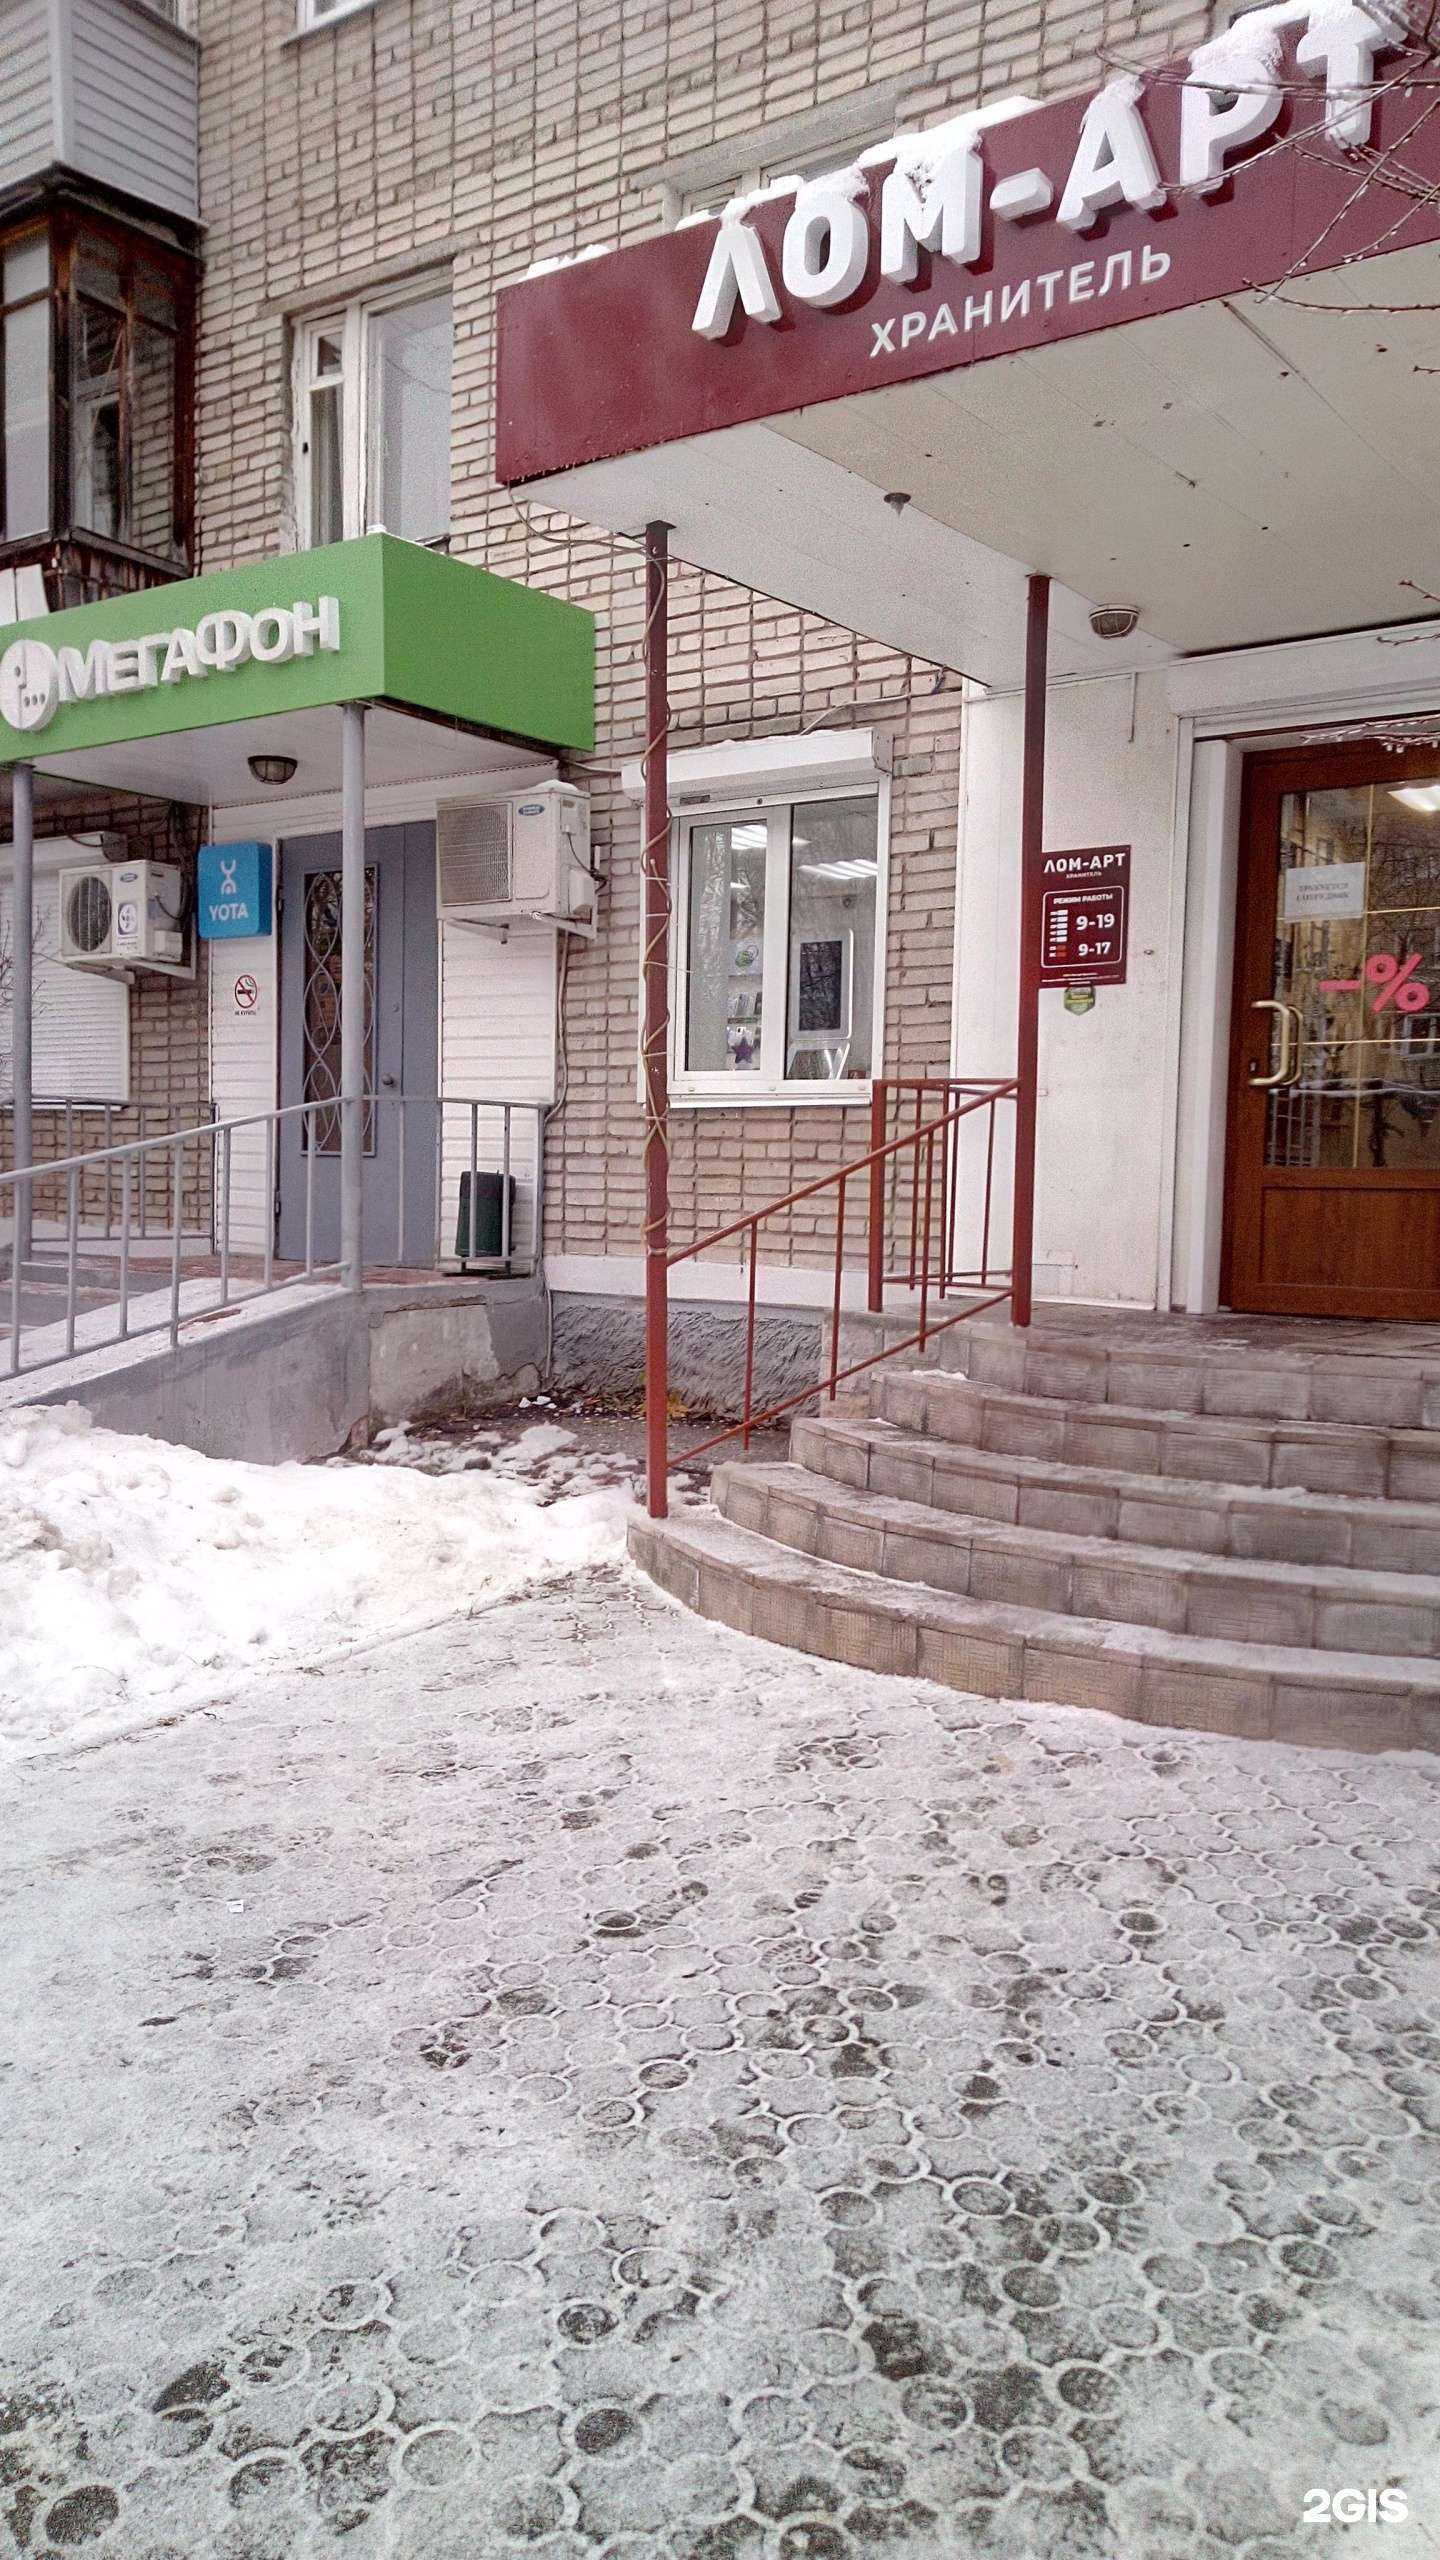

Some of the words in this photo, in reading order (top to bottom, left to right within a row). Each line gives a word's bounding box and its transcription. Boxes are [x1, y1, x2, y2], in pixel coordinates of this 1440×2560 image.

[691, 5, 1392, 340] ЛОМ-АРТ
[869, 245, 1171, 358] ХРАНИТЕЛЬ
[58, 596, 341, 702] МЕГАФОН
[1044, 853, 1126, 873] ЛОМ-АРТ
[1053, 896, 1081, 905] РЕЖИМ
[1082, 893, 1113, 902] РАБОТЫ
[209, 902, 249, 921] YOTA
[1076, 913, 1115, 930] 9-19
[1078, 941, 1112, 957] 9-17
